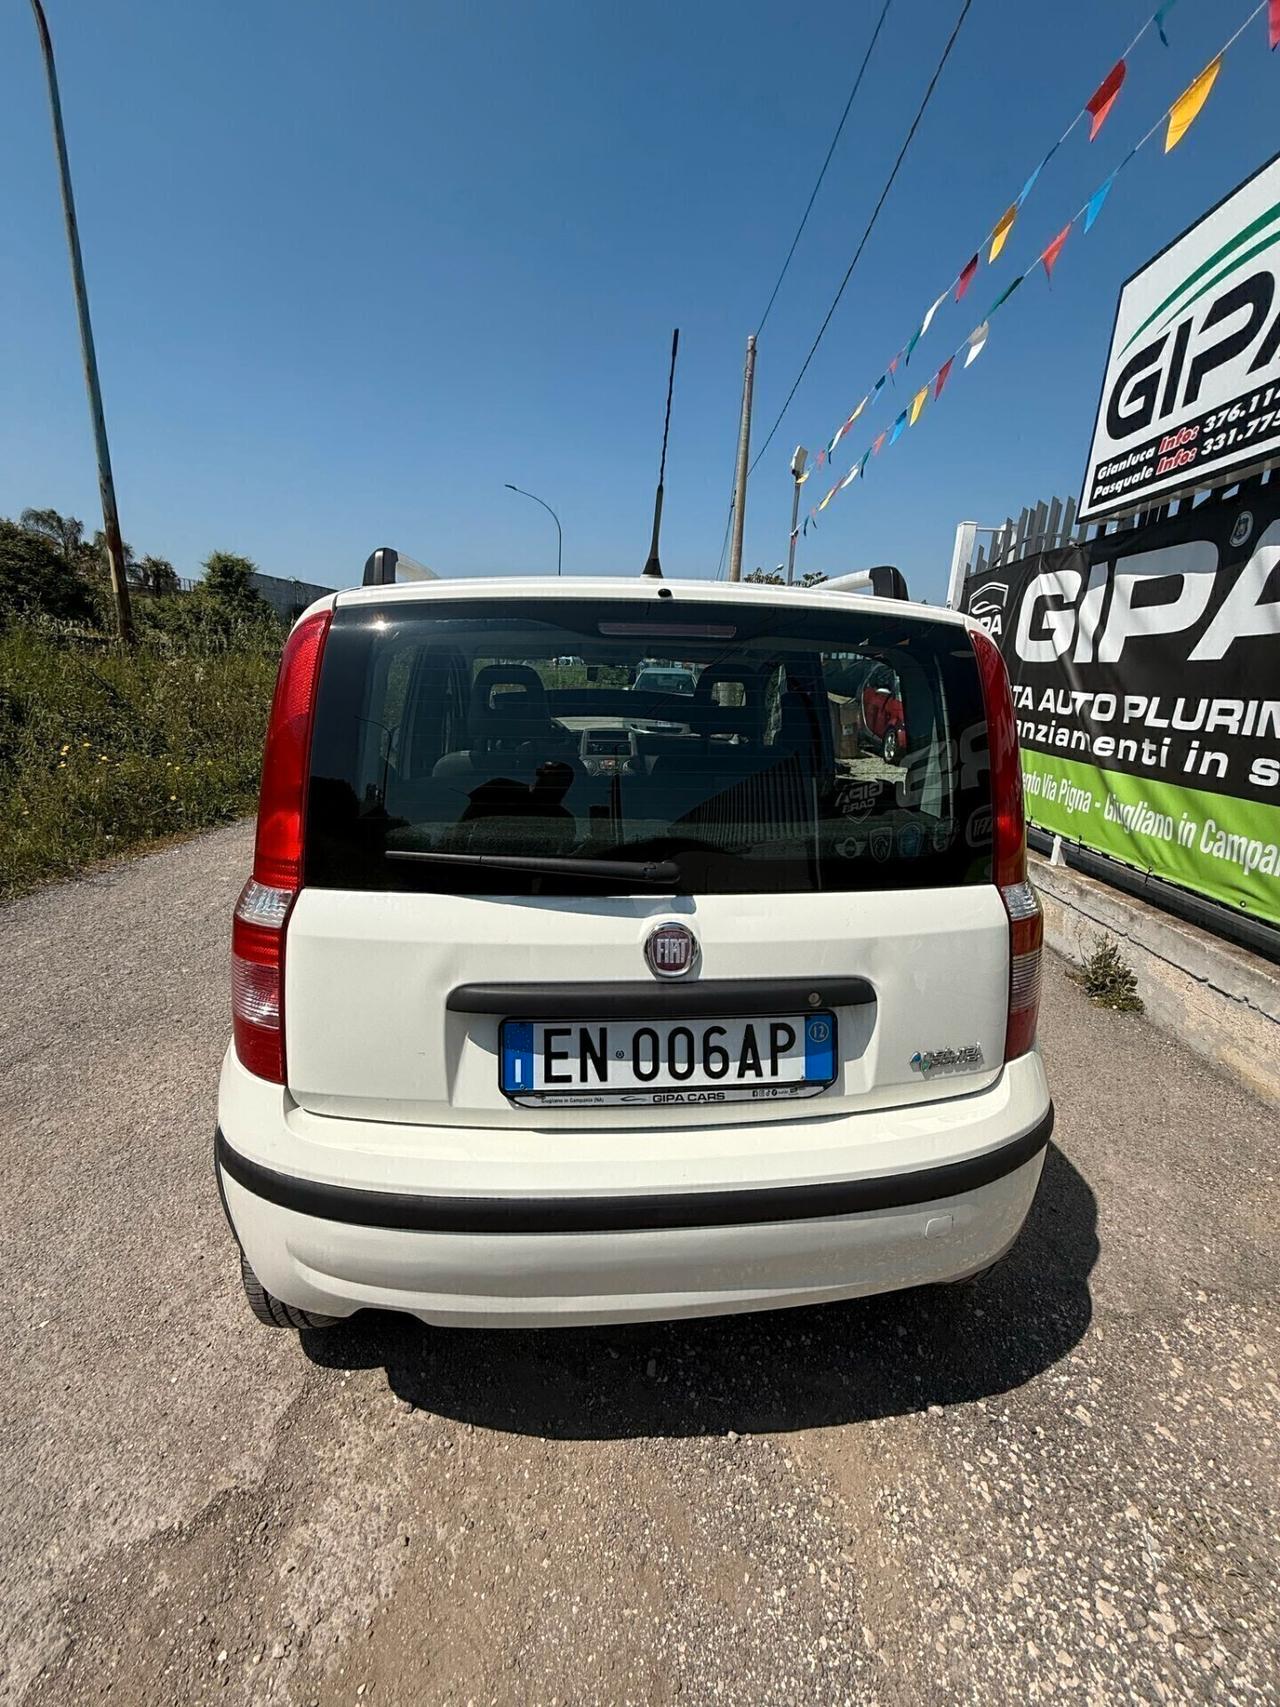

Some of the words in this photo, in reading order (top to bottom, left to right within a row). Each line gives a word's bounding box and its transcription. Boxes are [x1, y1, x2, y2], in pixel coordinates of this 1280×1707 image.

[1097, 445, 1156, 480] Gianluca
[1158, 425, 1200, 455] Info:
[1093, 464, 1153, 499] Pasquale
[1155, 447, 1197, 476] Info:
[976, 614, 1002, 635] PA
[1010, 685, 1034, 710] TA
[1038, 688, 1117, 722] AUTO
[1183, 740, 1229, 778] in
[1041, 772, 1057, 801] Via
[1058, 776, 1092, 814] Pigna
[1104, 792, 1173, 841] Giugliano
[1177, 812, 1197, 848] in
[1200, 819, 1280, 877] Campa
[656, 938, 688, 964] FIAT
[544, 1027, 608, 1083] EN
[632, 1022, 796, 1082] 006AP
[652, 1093, 687, 1103] GIPA
[688, 1091, 725, 1102] CARS
